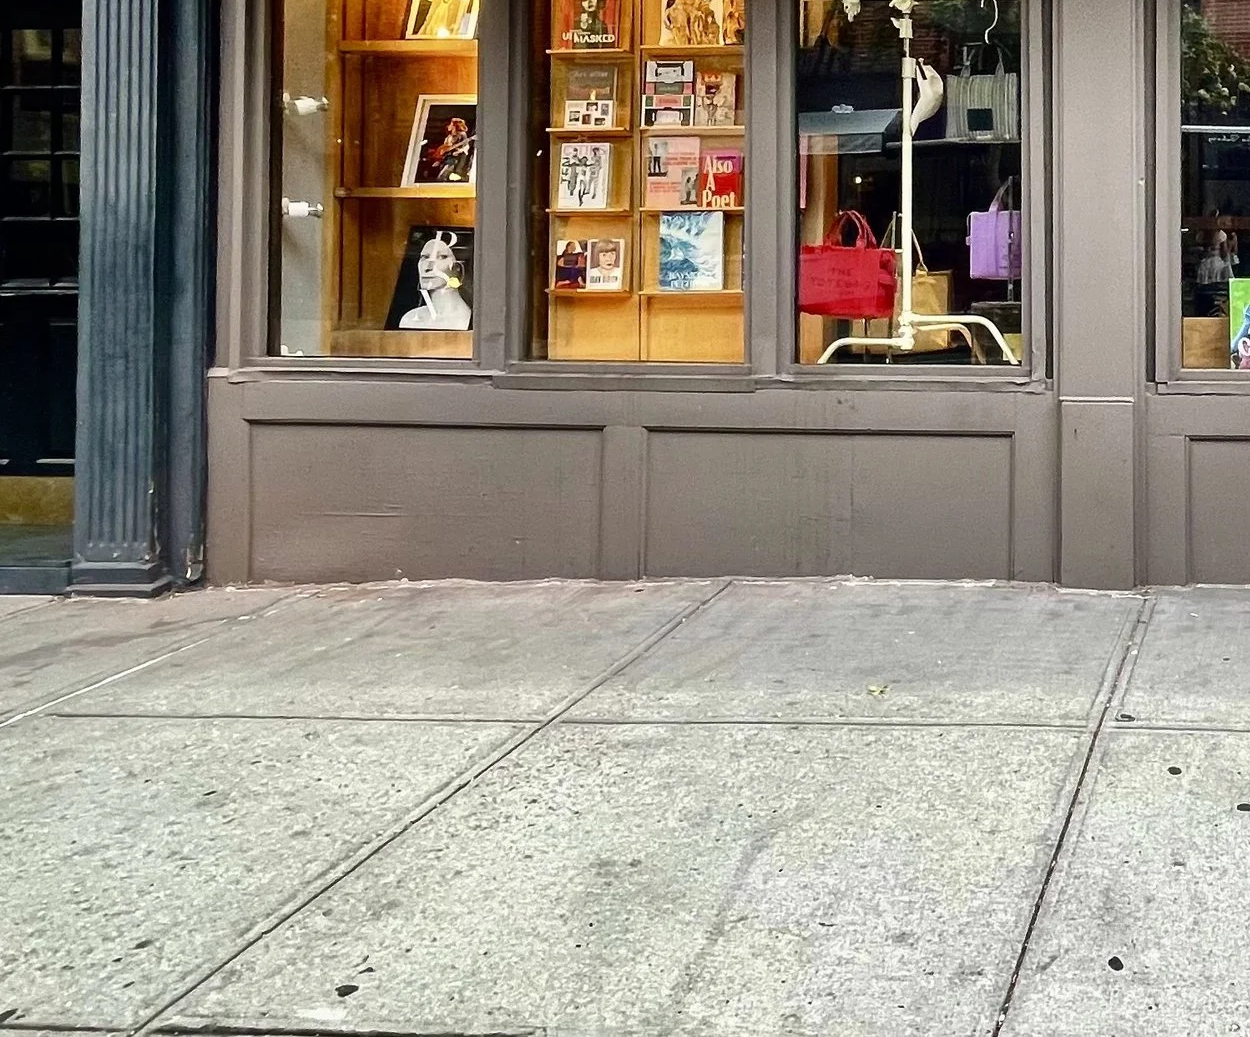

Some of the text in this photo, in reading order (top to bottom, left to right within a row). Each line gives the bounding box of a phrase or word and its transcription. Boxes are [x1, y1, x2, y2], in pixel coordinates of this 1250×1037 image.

[703, 155, 734, 174] Also
[705, 171, 716, 191] A
[702, 190, 736, 208] Poet
